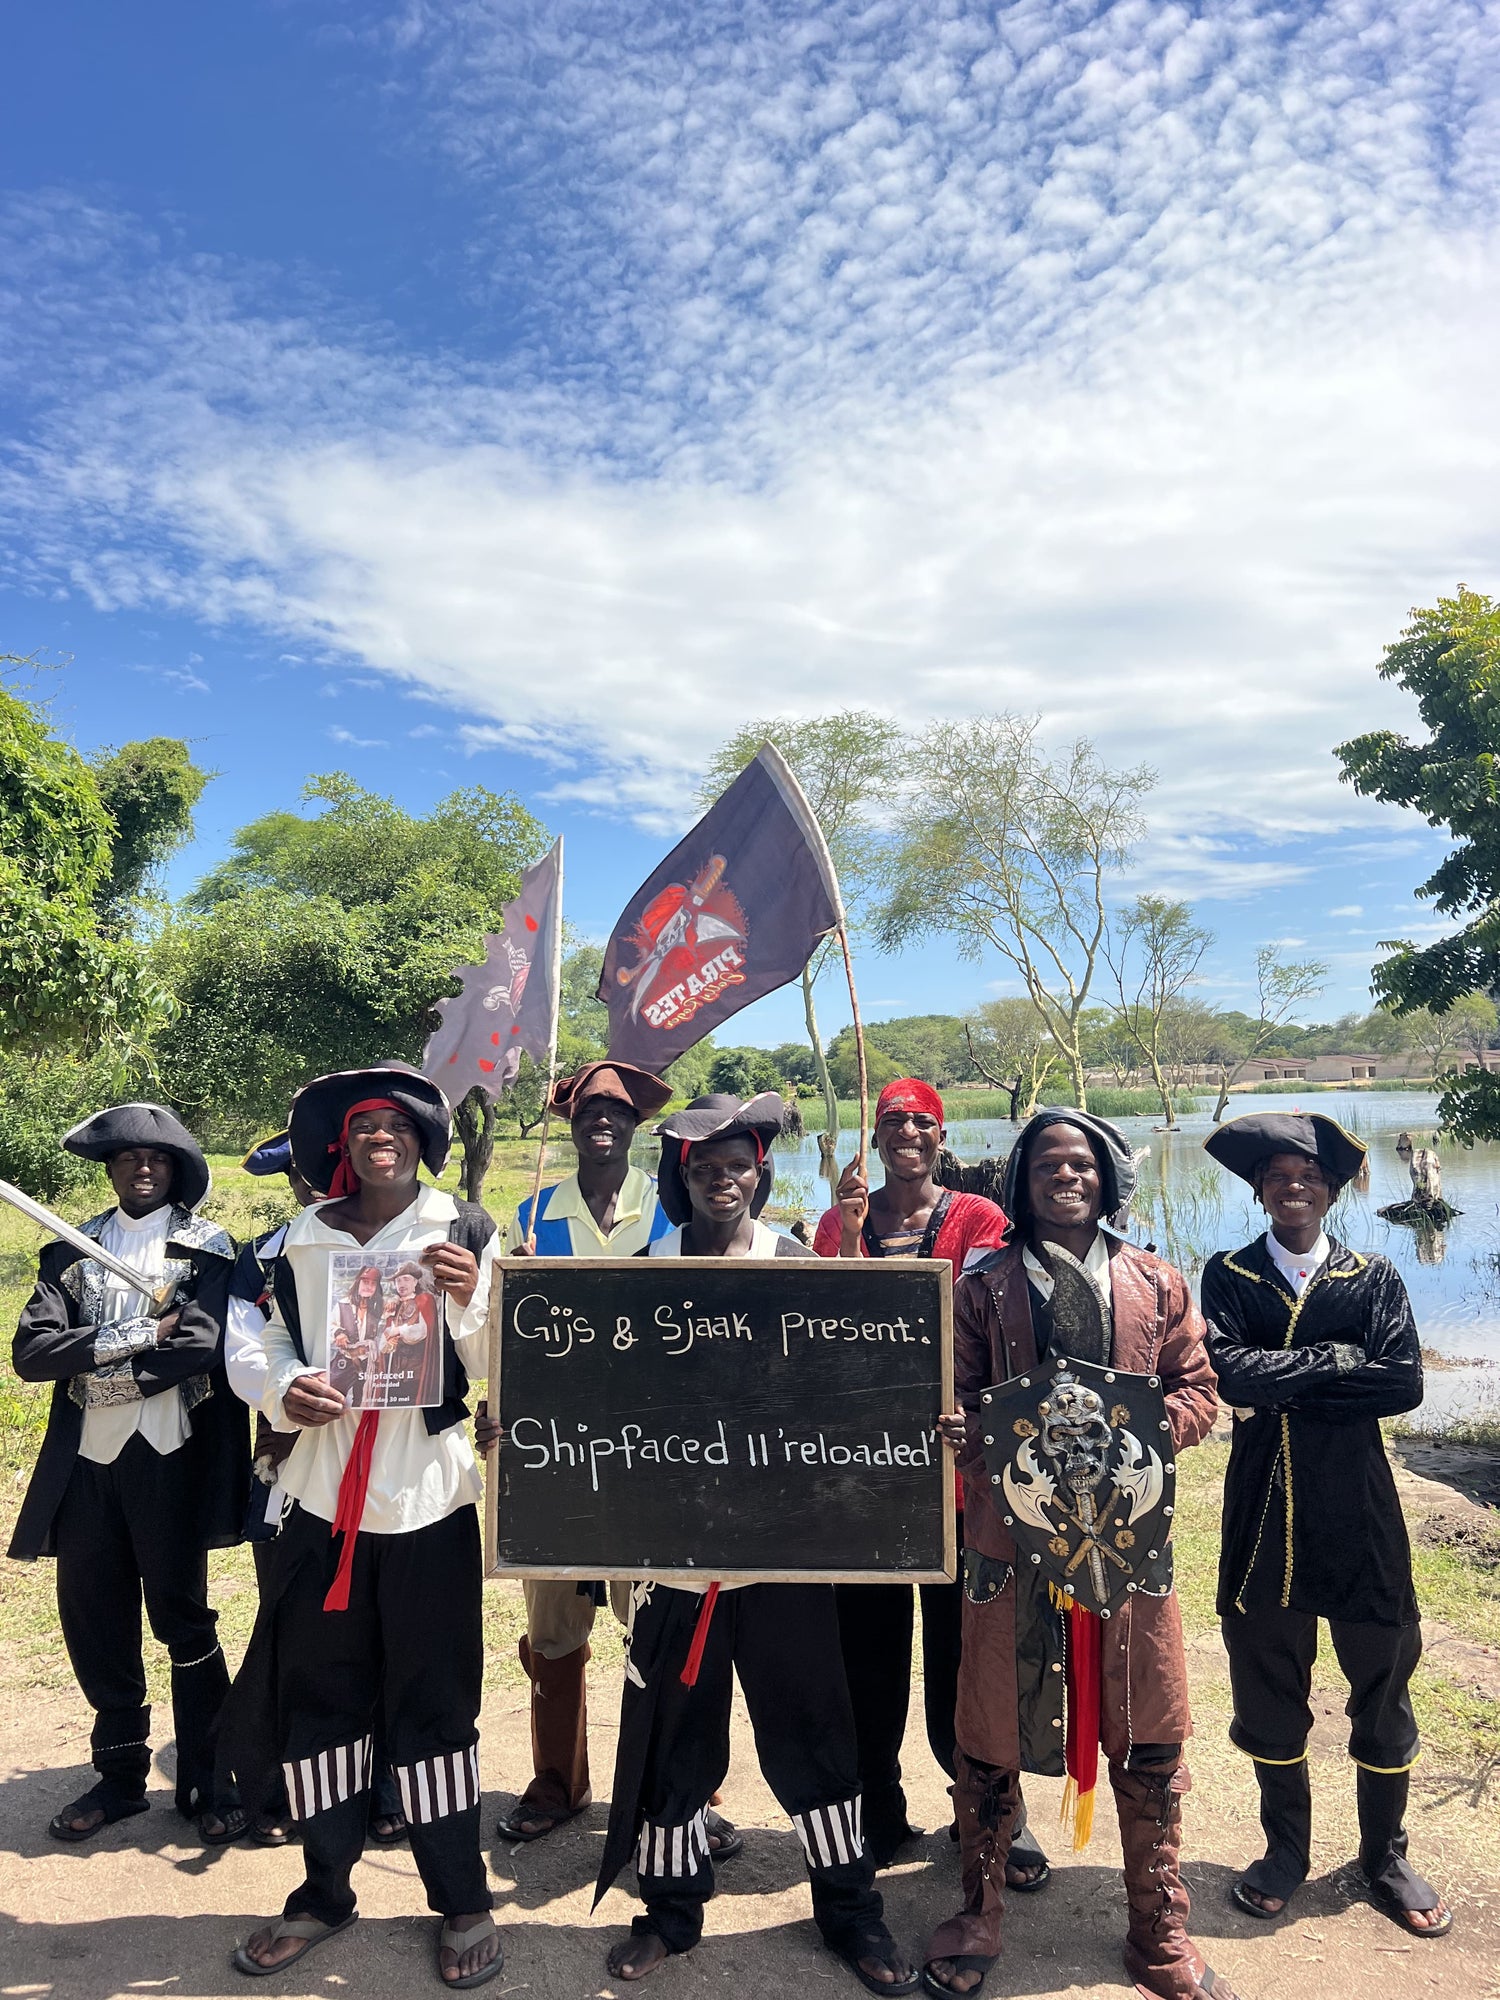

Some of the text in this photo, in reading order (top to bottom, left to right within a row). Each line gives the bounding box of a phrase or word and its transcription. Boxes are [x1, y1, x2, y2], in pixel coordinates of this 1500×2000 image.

[513, 1294, 596, 1358] Gijs
[612, 1316, 639, 1351] &
[654, 1300, 753, 1355] Sjaak
[358, 1371, 414, 1382] Shipfaced II
[511, 1417, 729, 1491] Shipfaced
